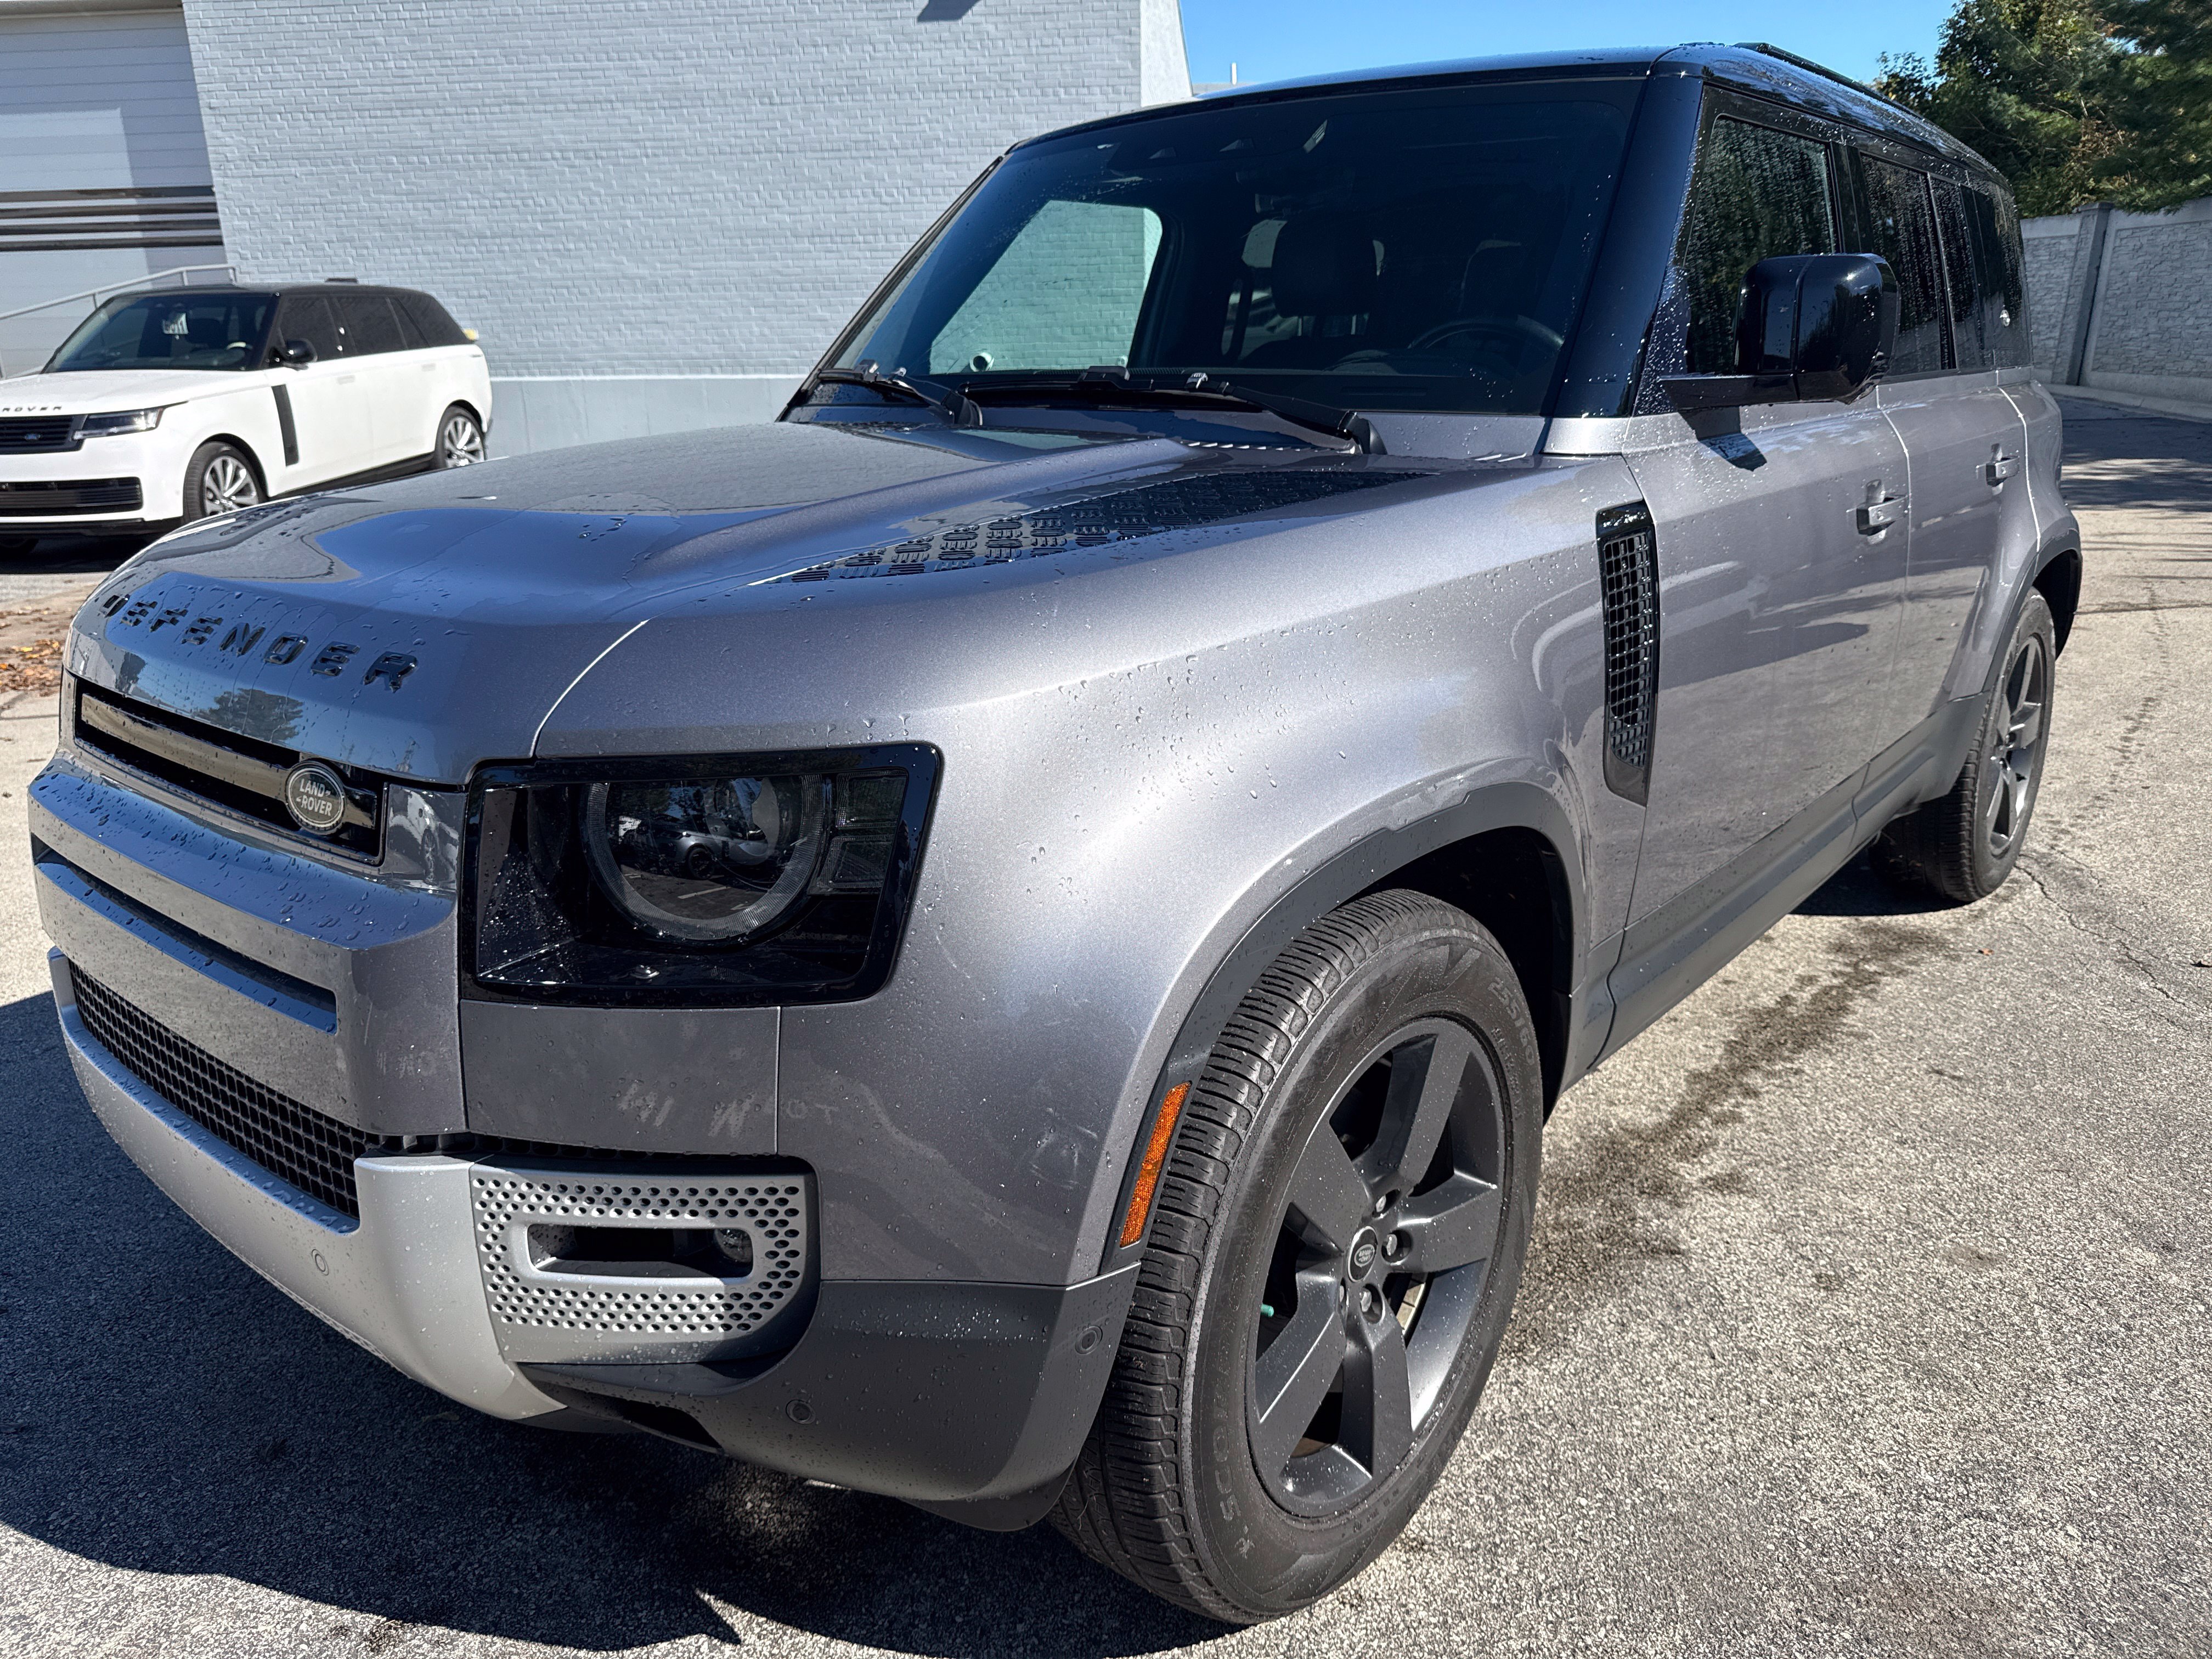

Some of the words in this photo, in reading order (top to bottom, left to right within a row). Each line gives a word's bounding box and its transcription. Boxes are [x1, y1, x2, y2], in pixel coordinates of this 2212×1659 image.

[100, 594, 417, 693] DEFENDER
[299, 778, 325, 797] LAND
[301, 794, 332, 816] ROVER
